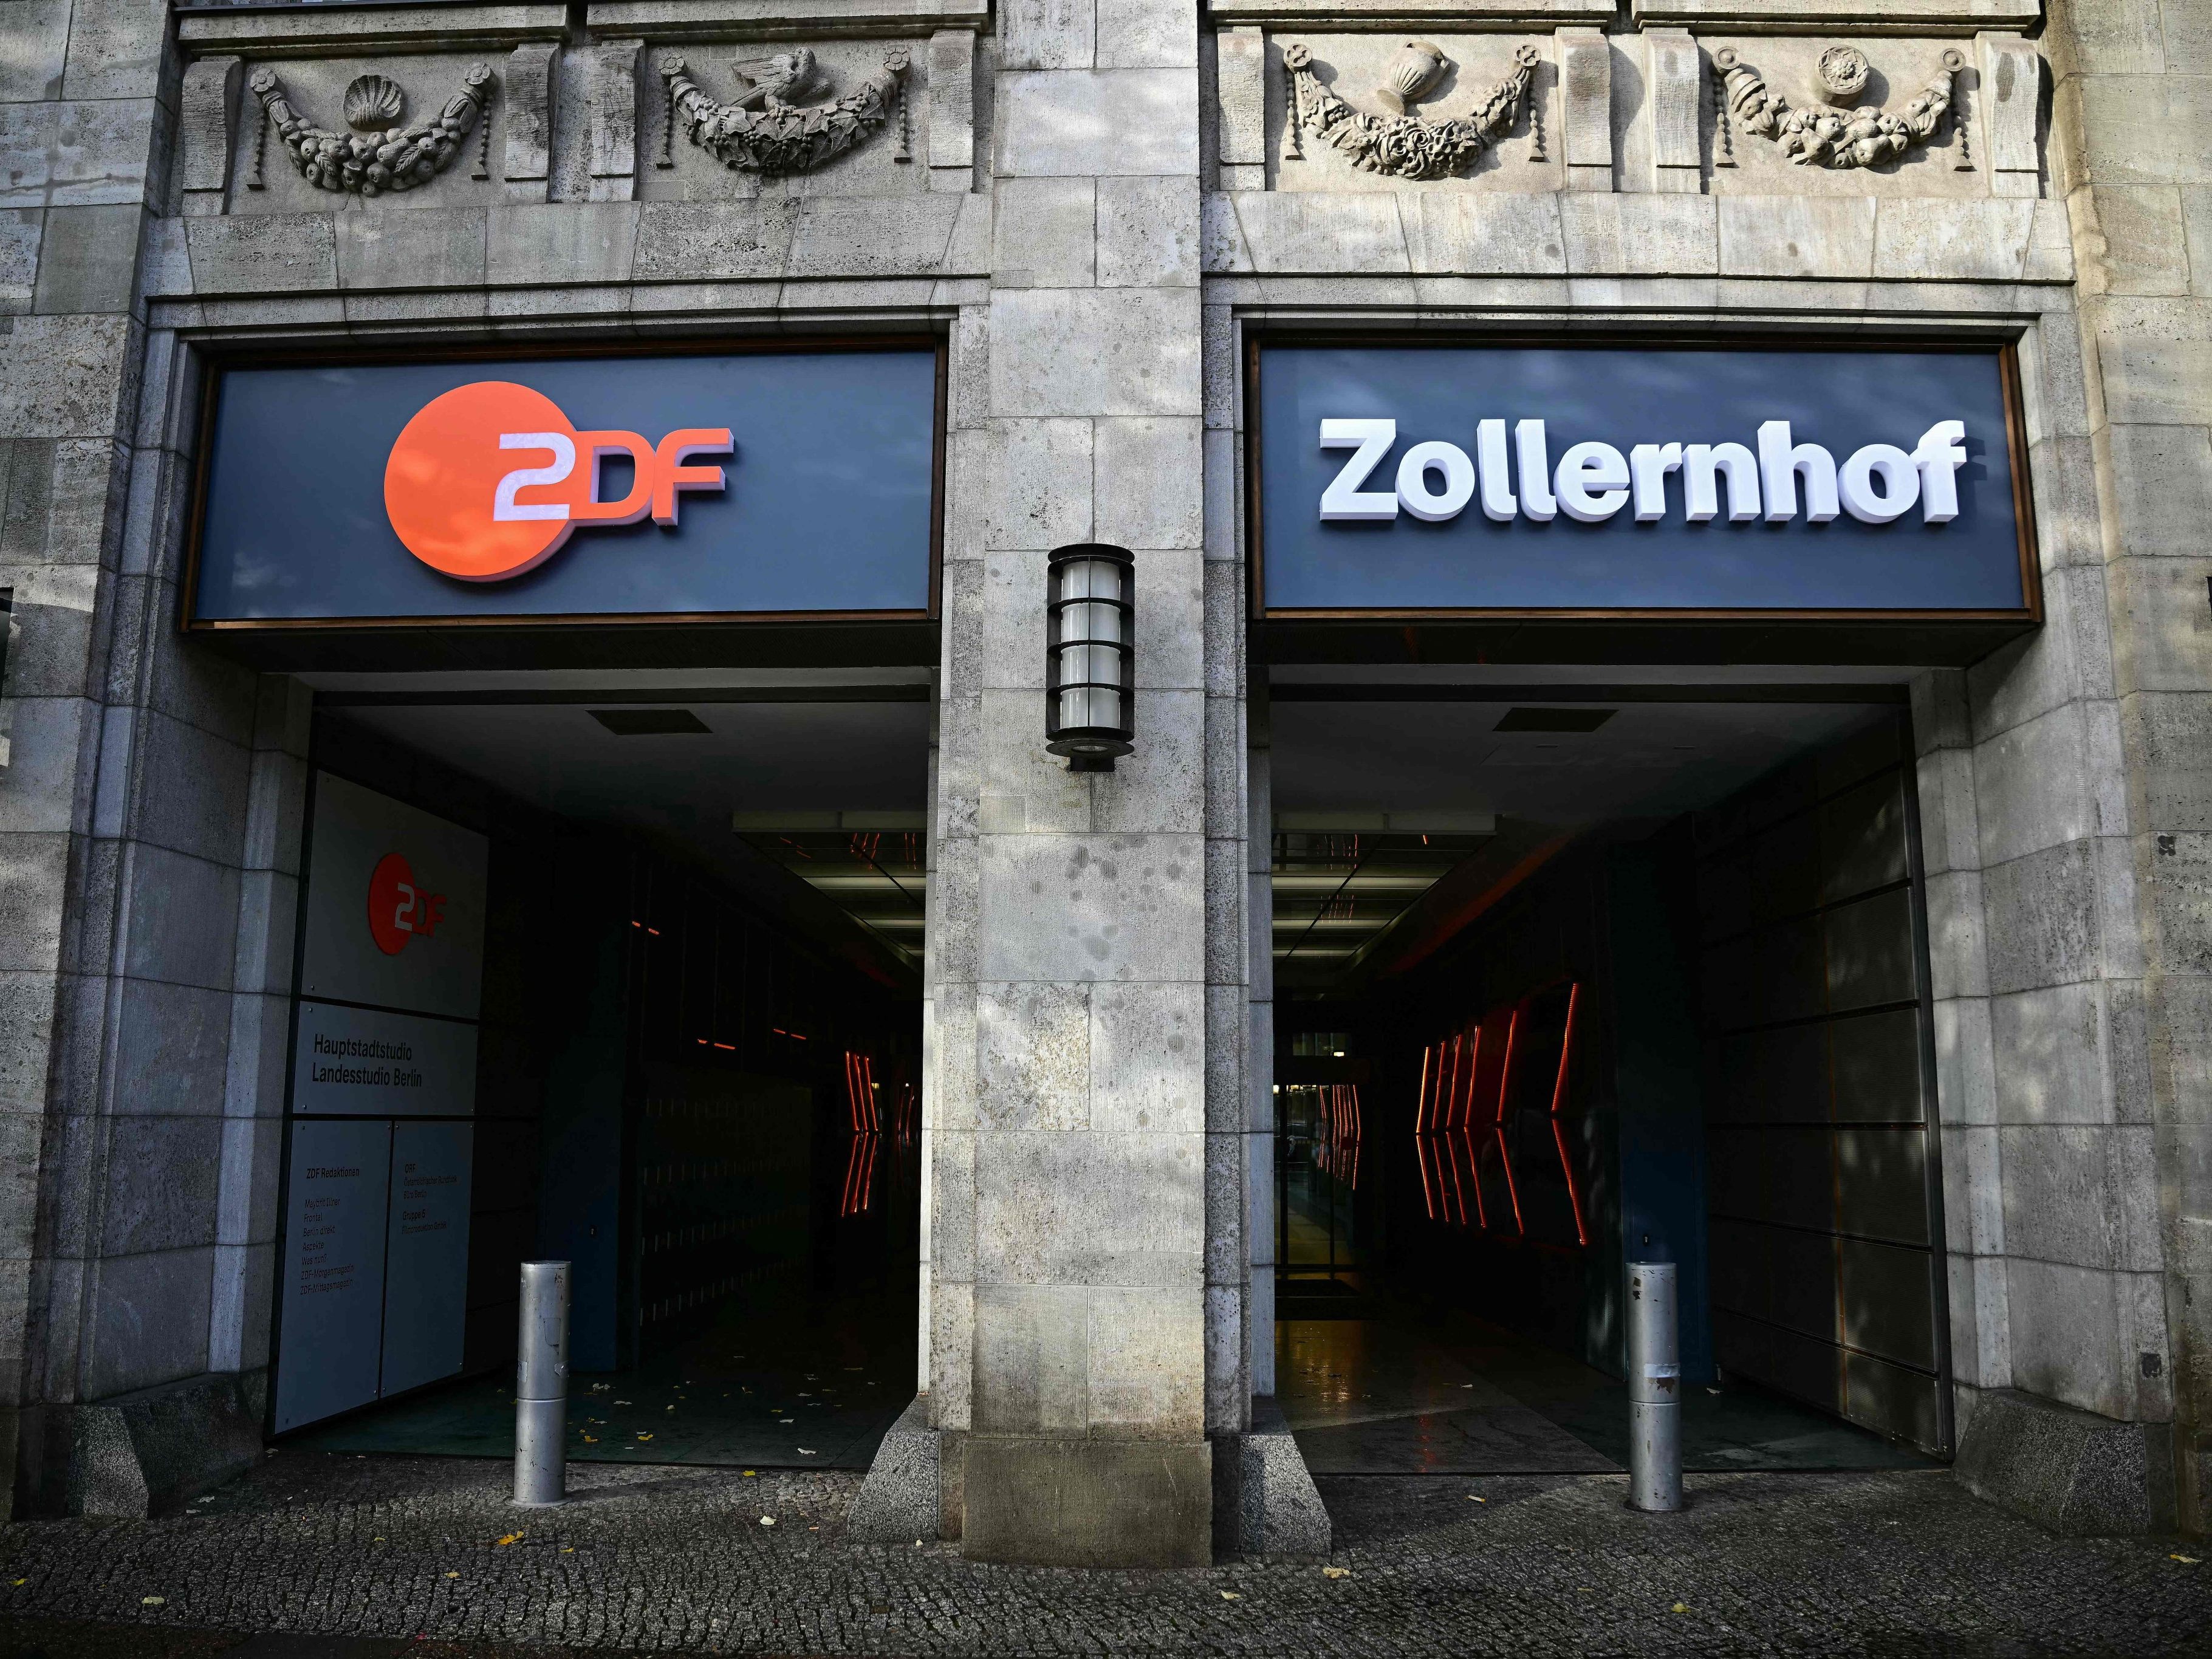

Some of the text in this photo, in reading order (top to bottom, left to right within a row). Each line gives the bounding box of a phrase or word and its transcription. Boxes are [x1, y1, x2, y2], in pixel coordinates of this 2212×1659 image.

[1319, 418, 1967, 525] Zollernhof
[313, 1033, 412, 1061] Hauptstadtstudio
[312, 1062, 422, 1087] Landesstudio Berlin
[306, 1166, 360, 1178] ZDF Redaktionen
[305, 1197, 340, 1210] Maybrit Illner
[304, 1213, 323, 1222] Frontal
[402, 1209, 426, 1221] Gruppe 5
[303, 1225, 335, 1237] Berlin direkt
[303, 1242, 324, 1254] Aspekte
[301, 1253, 327, 1265] Was nun?
[301, 1264, 354, 1280] ZDF-Morgenmagazin
[300, 1278, 354, 1295] ZDF-Mittagsmagazin
